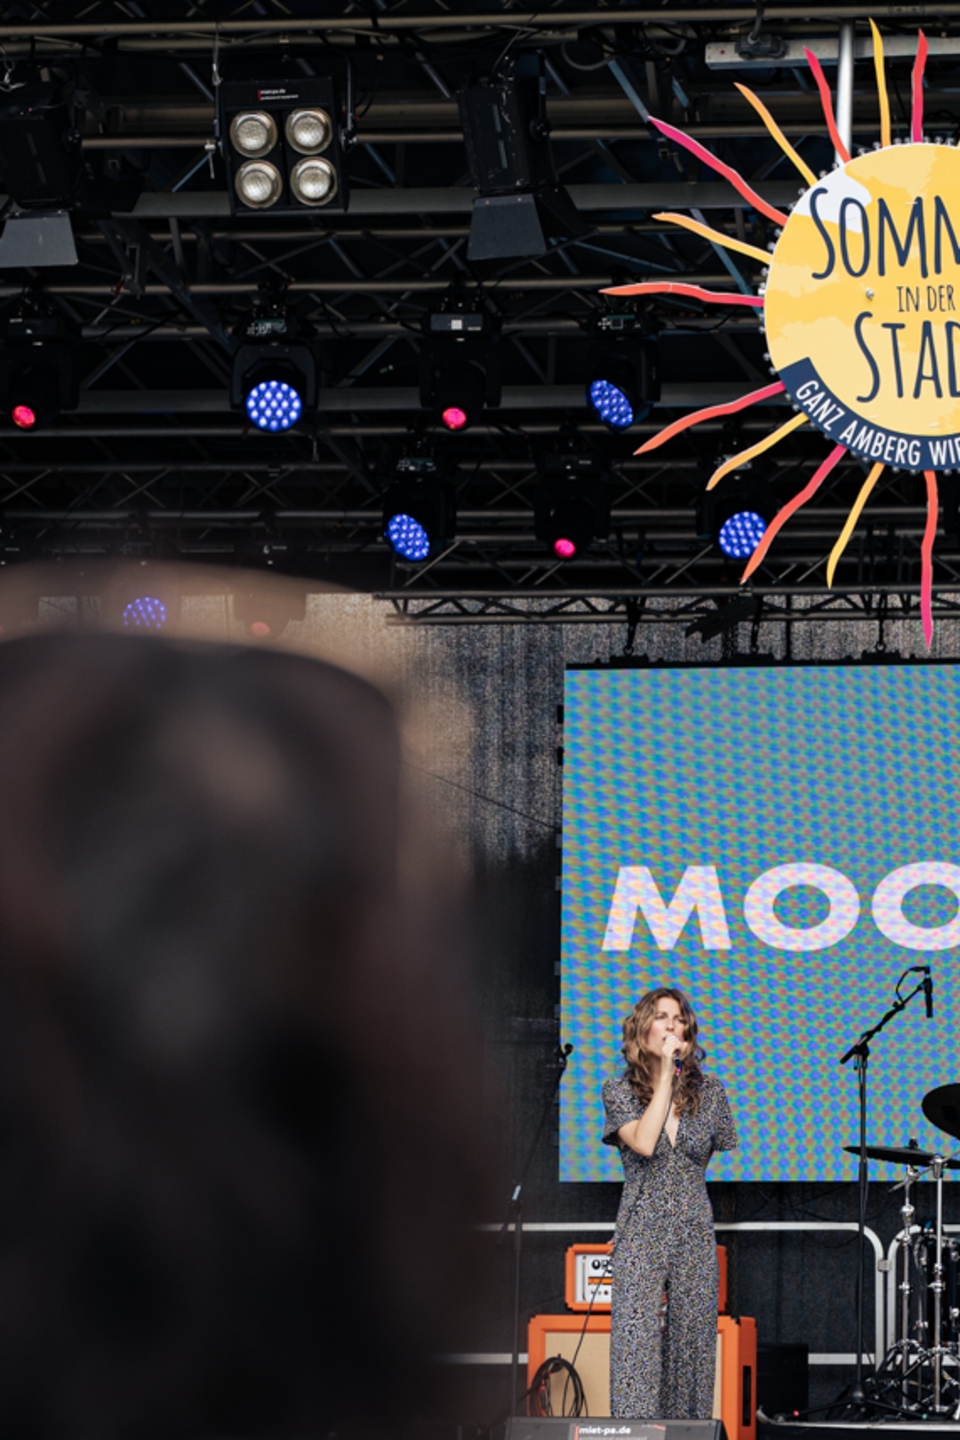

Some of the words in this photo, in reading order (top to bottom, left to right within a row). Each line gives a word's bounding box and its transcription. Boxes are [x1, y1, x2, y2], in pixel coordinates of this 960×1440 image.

[896, 285, 920, 312] IN
[927, 284, 956, 312] DER
[795, 380, 847, 432] GANZ
[839, 420, 921, 466] AMBERG
